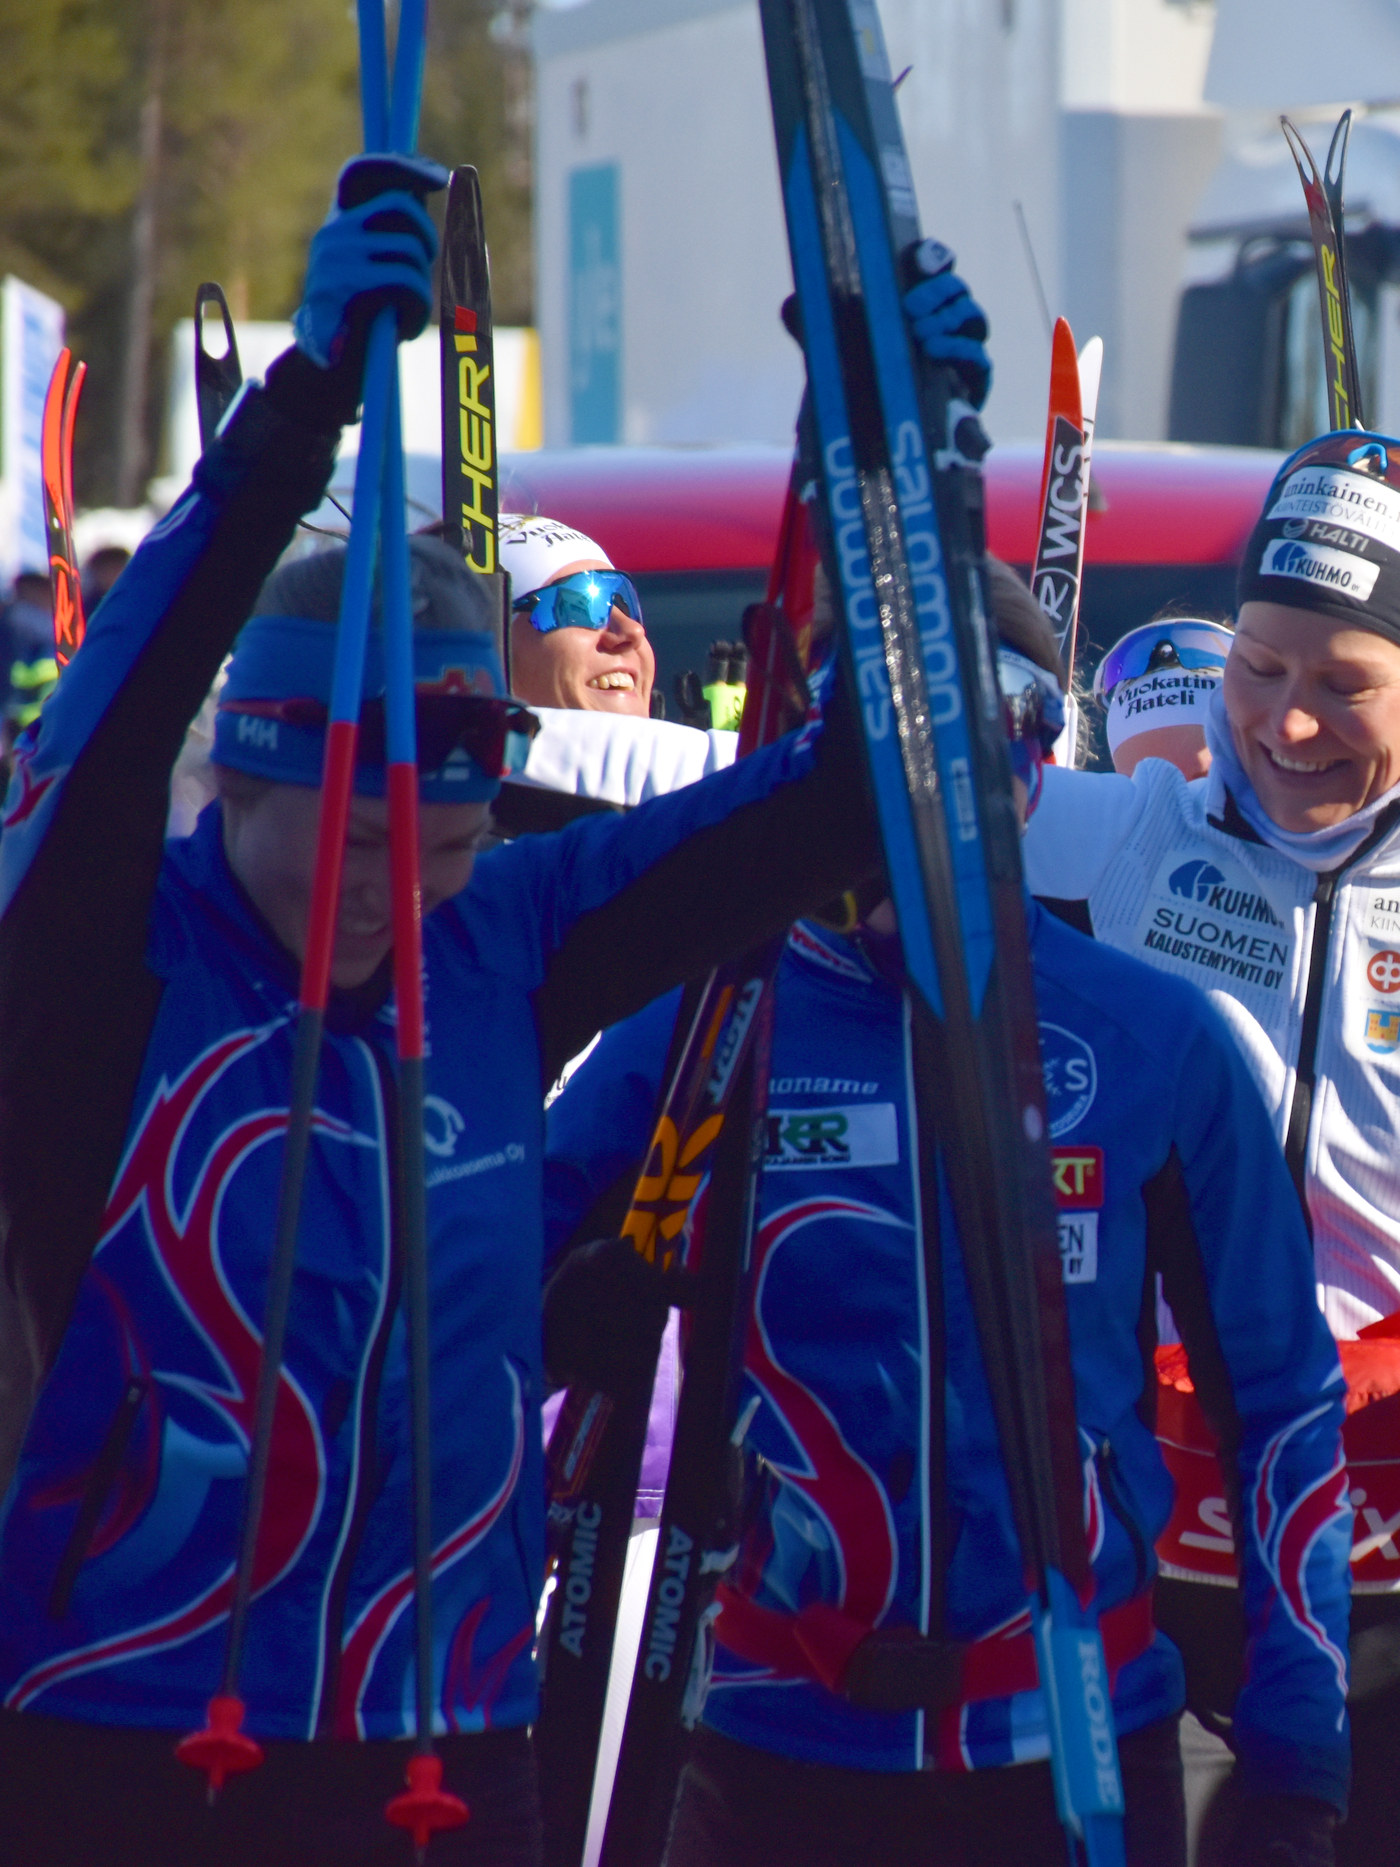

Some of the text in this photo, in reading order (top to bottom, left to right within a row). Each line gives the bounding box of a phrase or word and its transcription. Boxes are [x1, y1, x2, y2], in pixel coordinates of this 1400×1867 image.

[458, 356, 497, 575] CHER
[1042, 443, 1084, 561] WCS
[897, 419, 963, 726] salomon
[1298, 558, 1353, 588] KUHMO
[1310, 523, 1369, 553] HALTI
[1116, 673, 1216, 707] Vuokatin
[1124, 690, 1195, 720] Aateli
[1143, 927, 1284, 990] KALUSTEMYYNTI OY
[1152, 907, 1289, 967] SUOMEN
[559, 1503, 601, 1658] ATOMIC
[645, 1525, 694, 1682] ATOMIC
[1077, 1640, 1121, 1807] RODE
